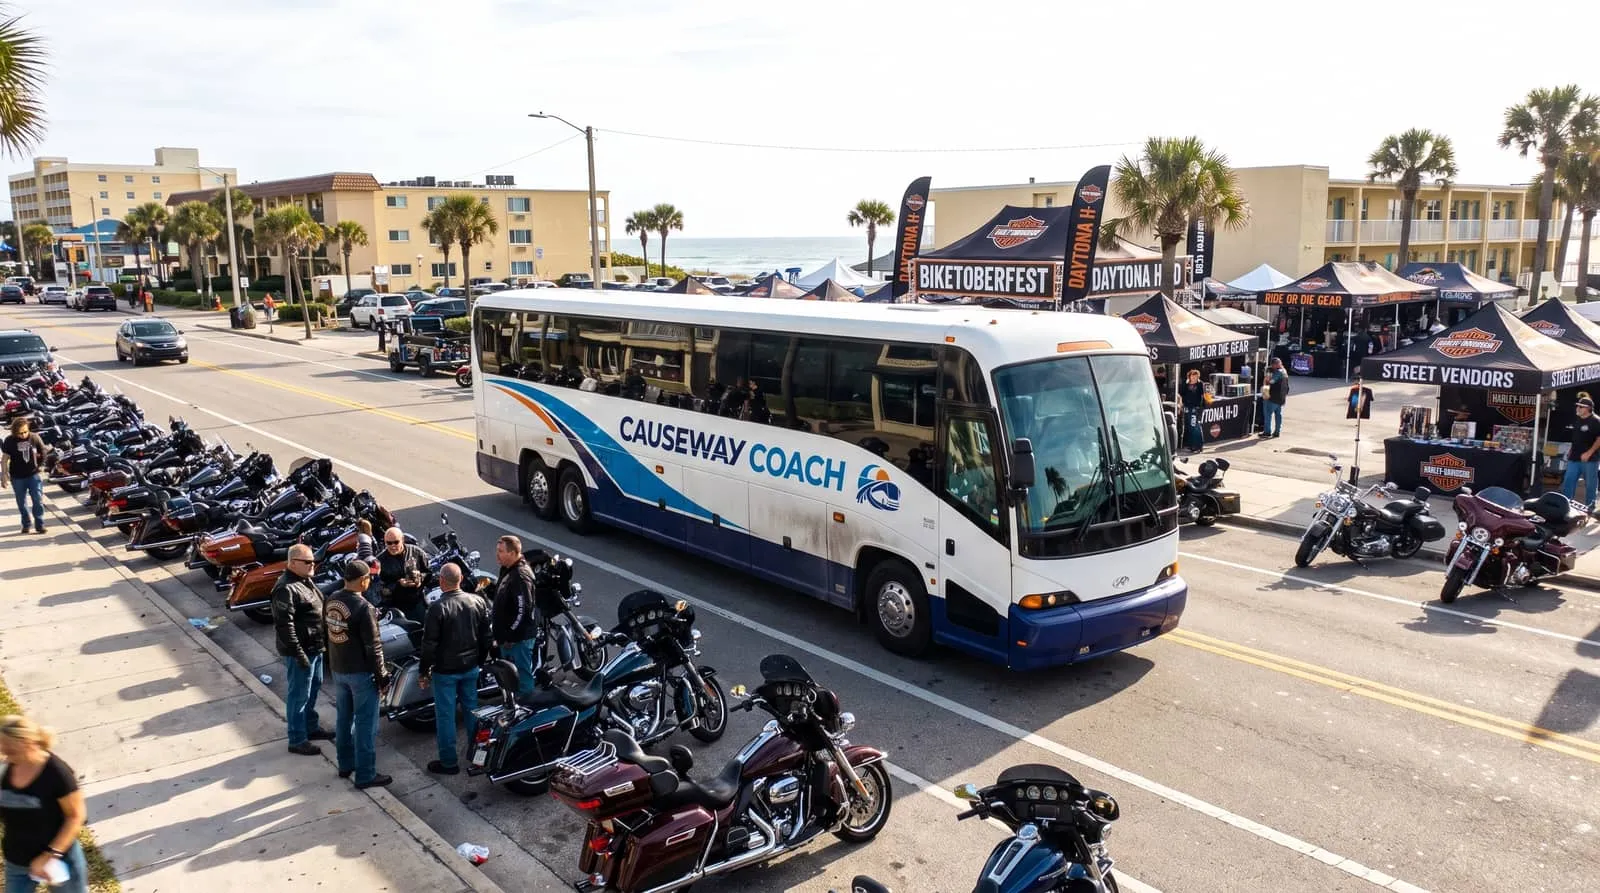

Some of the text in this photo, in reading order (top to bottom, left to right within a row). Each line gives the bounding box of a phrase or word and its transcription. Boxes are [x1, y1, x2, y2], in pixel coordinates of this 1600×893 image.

[899, 225, 919, 283] DAYTONA
[1068, 222, 1094, 289] DAYTONA
[919, 264, 1049, 294] BIKETOBERFEST
[1092, 264, 1151, 291] DAYTONA
[1264, 292, 1285, 304] RIDE
[1286, 293, 1298, 305] OR
[1300, 293, 1316, 306] DIE
[1317, 294, 1342, 306] GEAR
[1189, 340, 1249, 360] RIDE OR DIE GEAR
[1381, 363, 1514, 388] STREET VENDORS
[1551, 367, 1576, 388] STREET
[619, 415, 846, 492] CAUSEWAY COACH
